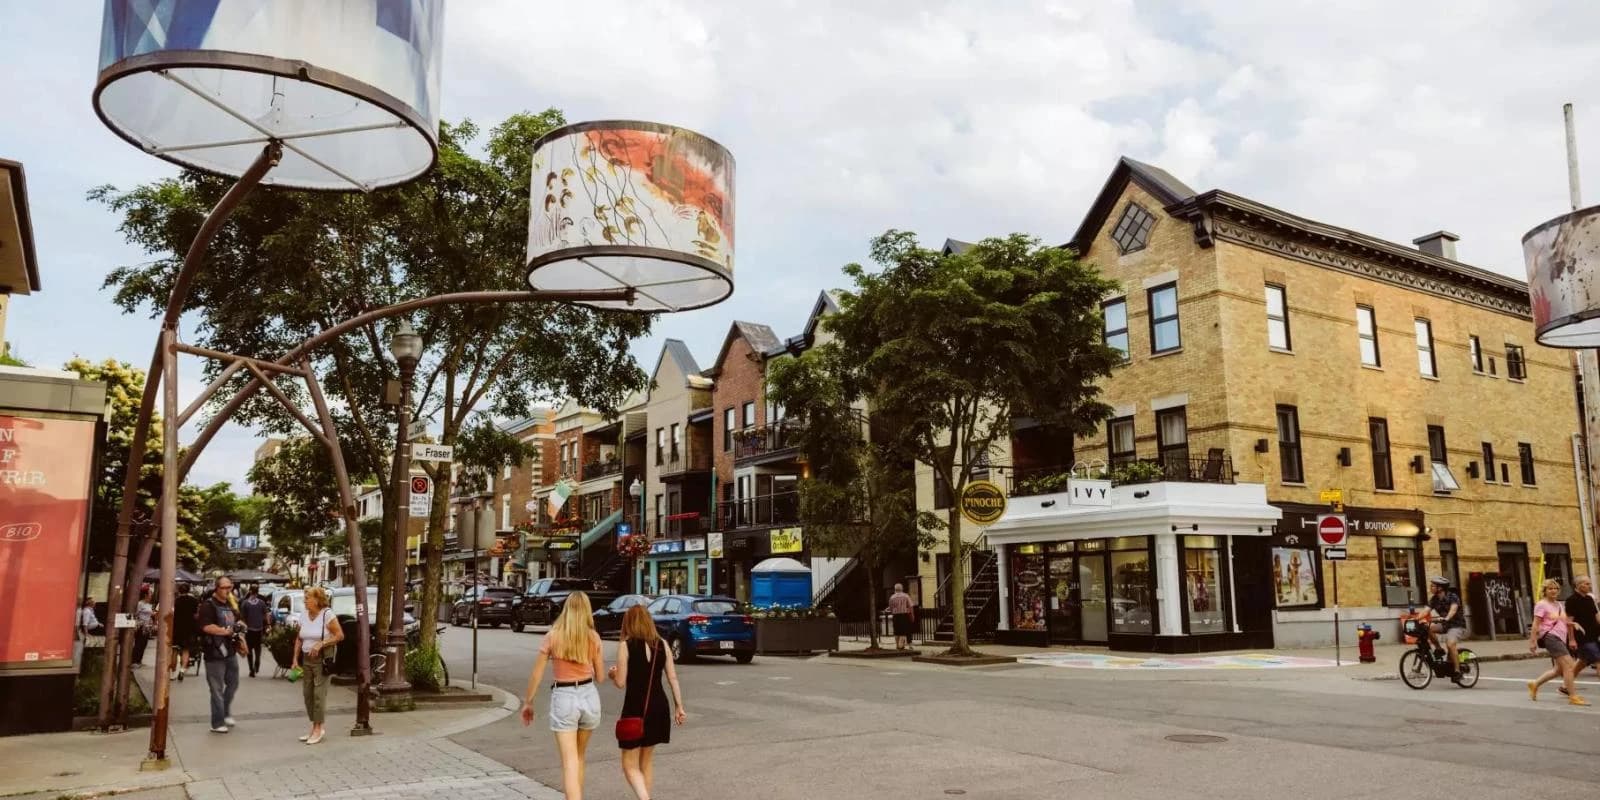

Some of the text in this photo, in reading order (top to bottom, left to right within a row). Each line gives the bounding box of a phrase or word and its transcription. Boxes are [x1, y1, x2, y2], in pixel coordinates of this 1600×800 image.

[425, 447, 451, 458] Fraser
[1074, 487, 1106, 499] IVY
[964, 496, 1003, 508] PINOCHE
[6, 526, 32, 538] BIO
